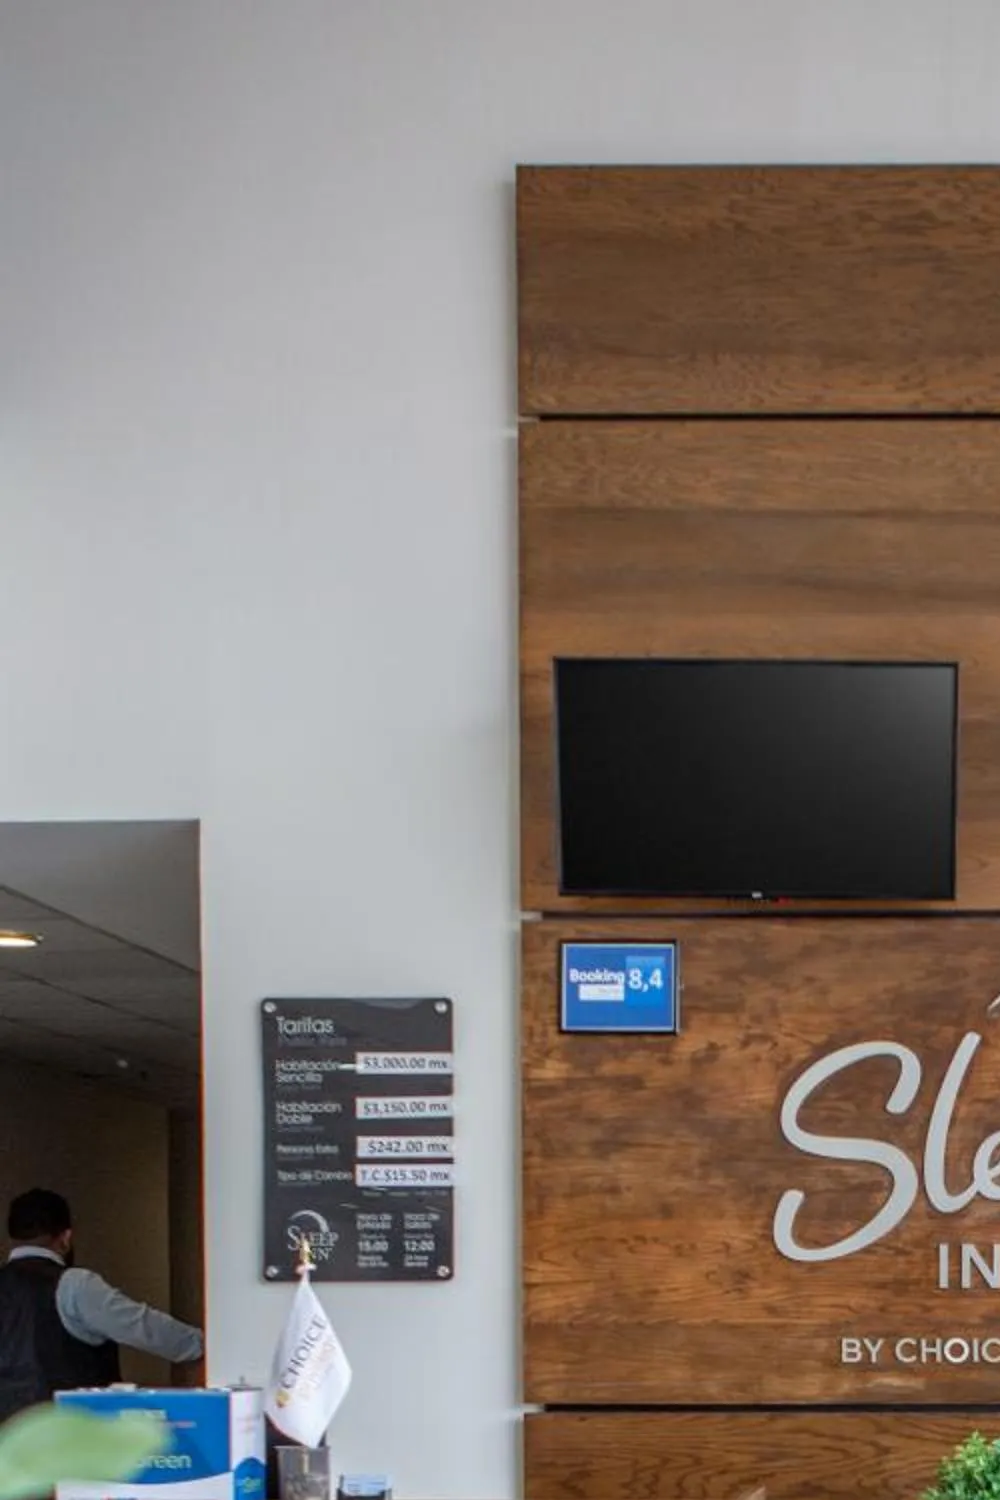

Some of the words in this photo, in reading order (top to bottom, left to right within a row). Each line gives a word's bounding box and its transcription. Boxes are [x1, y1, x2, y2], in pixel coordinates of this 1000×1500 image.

[569, 968, 625, 985] Booking
[629, 968, 664, 992] 8,4
[276, 1016, 335, 1034] Tarifas
[841, 1338, 885, 1363] BY
